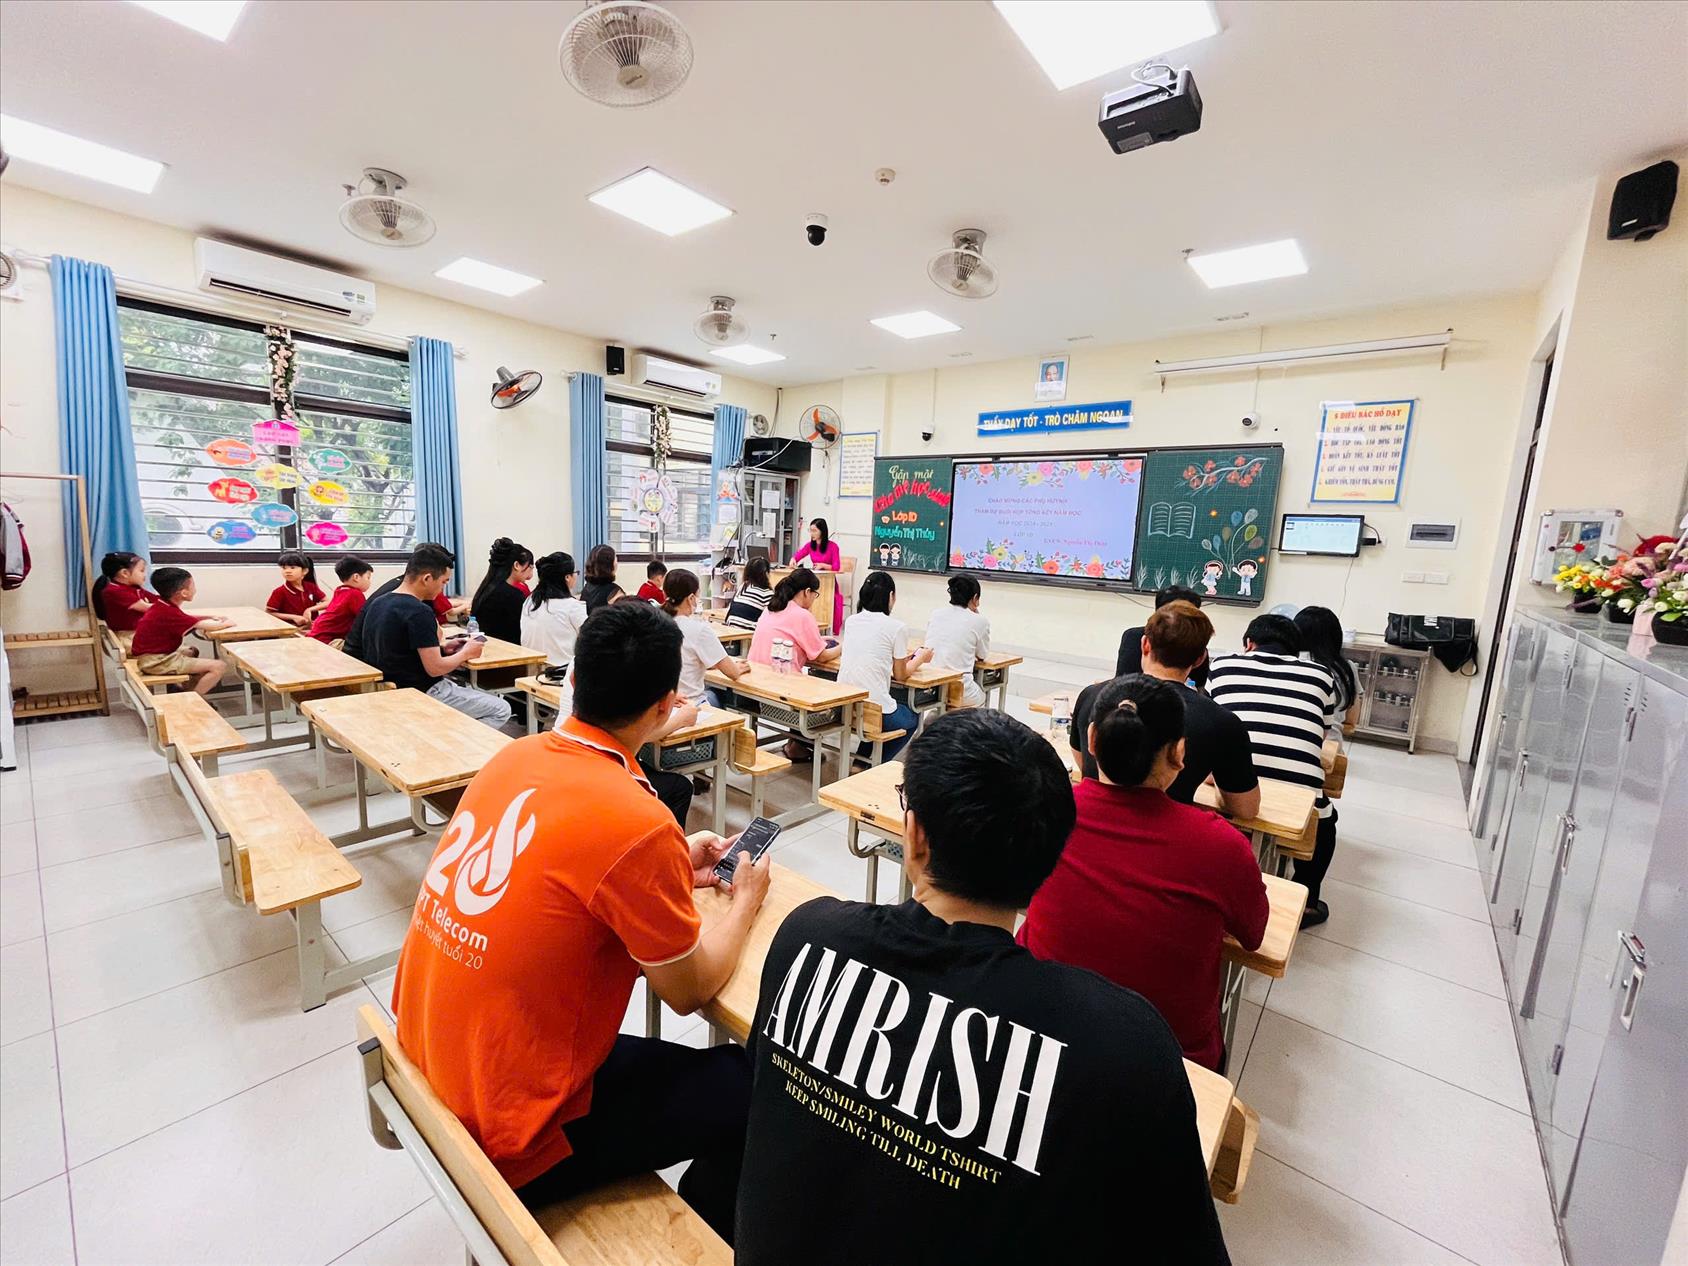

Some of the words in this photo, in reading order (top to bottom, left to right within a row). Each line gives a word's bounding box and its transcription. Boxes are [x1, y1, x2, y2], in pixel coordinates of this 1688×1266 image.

[1005, 417, 1022, 432] DẠY
[1023, 411, 1039, 428] TỐT
[1045, 411, 1060, 426] TRÒ
[1062, 410, 1088, 425] CHĂM
[1089, 409, 1123, 423] NGOAN
[1385, 408, 1402, 419] DẠY
[889, 465, 909, 488] Gặp
[914, 469, 934, 481] mặt
[892, 510, 908, 524] Lớp
[431, 899, 489, 952] Telecom
[443, 939, 465, 963] tuổi
[465, 952, 484, 970] 20
[763, 942, 1069, 1176] AMRISH
[771, 1052, 879, 1122] SKELETON/SMILEY
[880, 1114, 937, 1155] WORLD
[940, 1145, 1002, 1185] TSHIRT
[785, 1079, 810, 1105] KEEP
[809, 1099, 867, 1141] SMILING
[869, 1131, 902, 1162] TILL
[905, 1155, 961, 1190] DEATH
